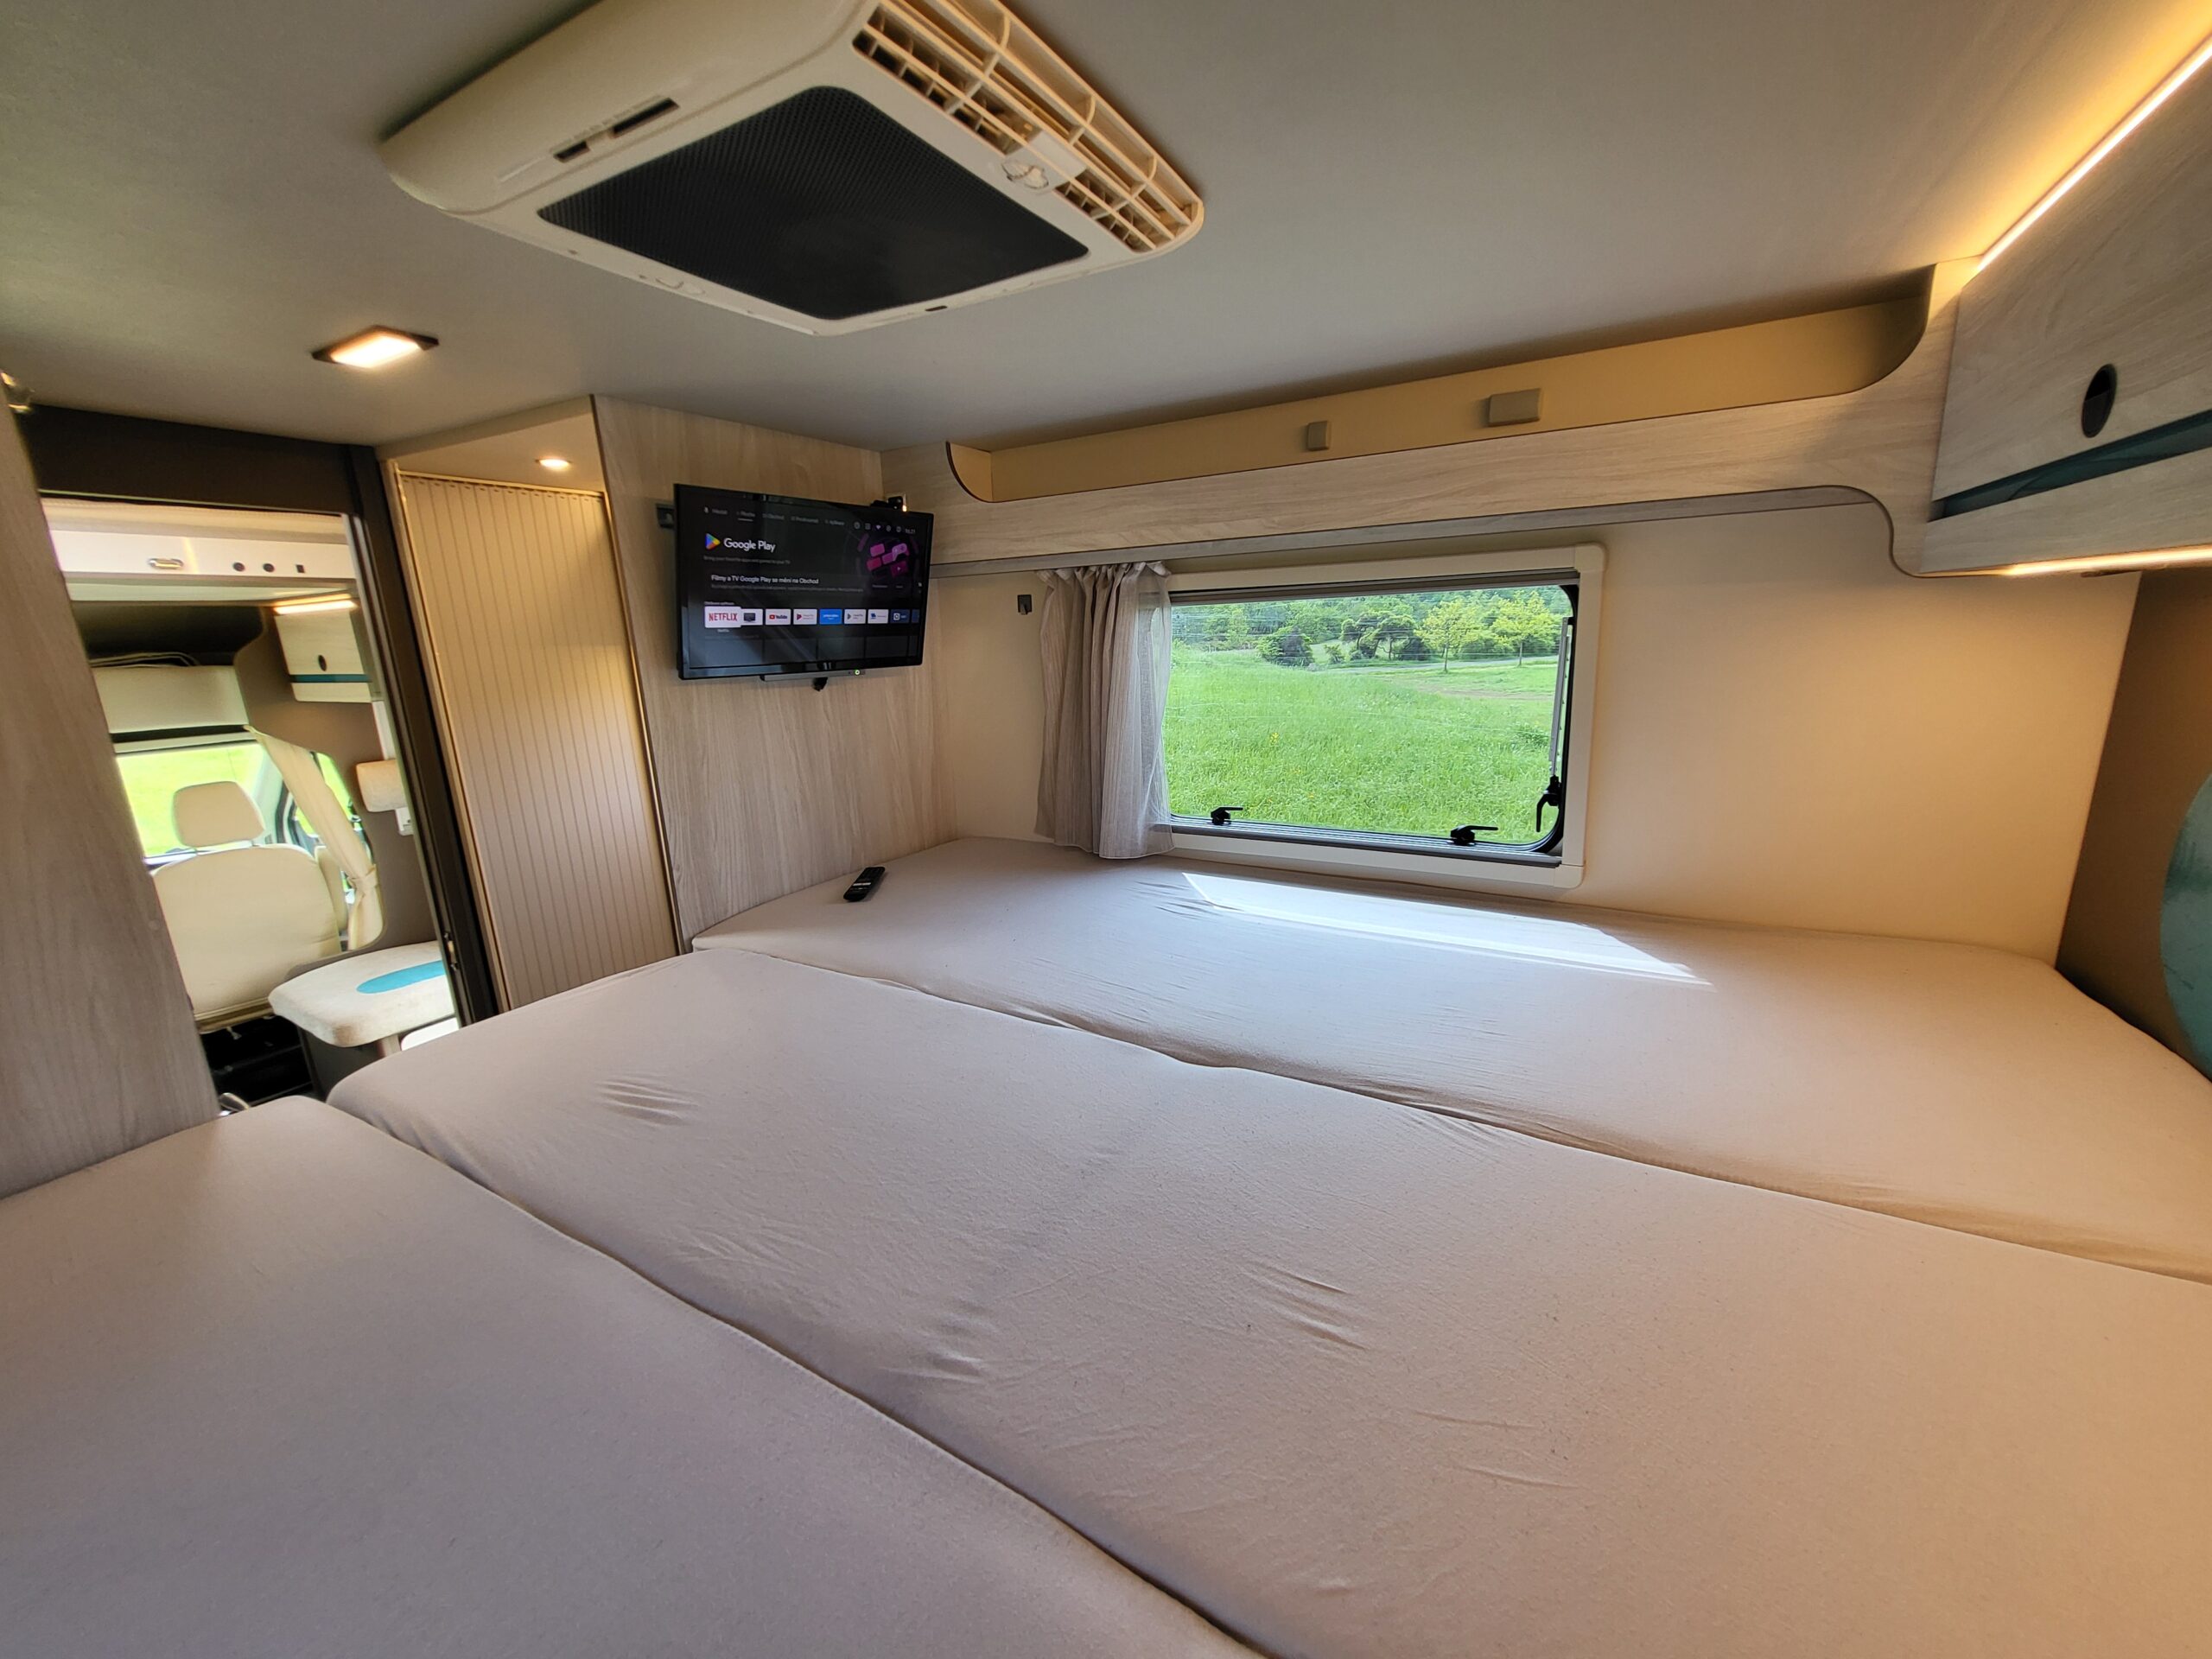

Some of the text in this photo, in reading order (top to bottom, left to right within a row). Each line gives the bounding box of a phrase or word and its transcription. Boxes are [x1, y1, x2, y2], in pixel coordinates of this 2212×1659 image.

[723, 537, 776, 553] Google Play
[709, 613, 738, 621] NETFLIX
